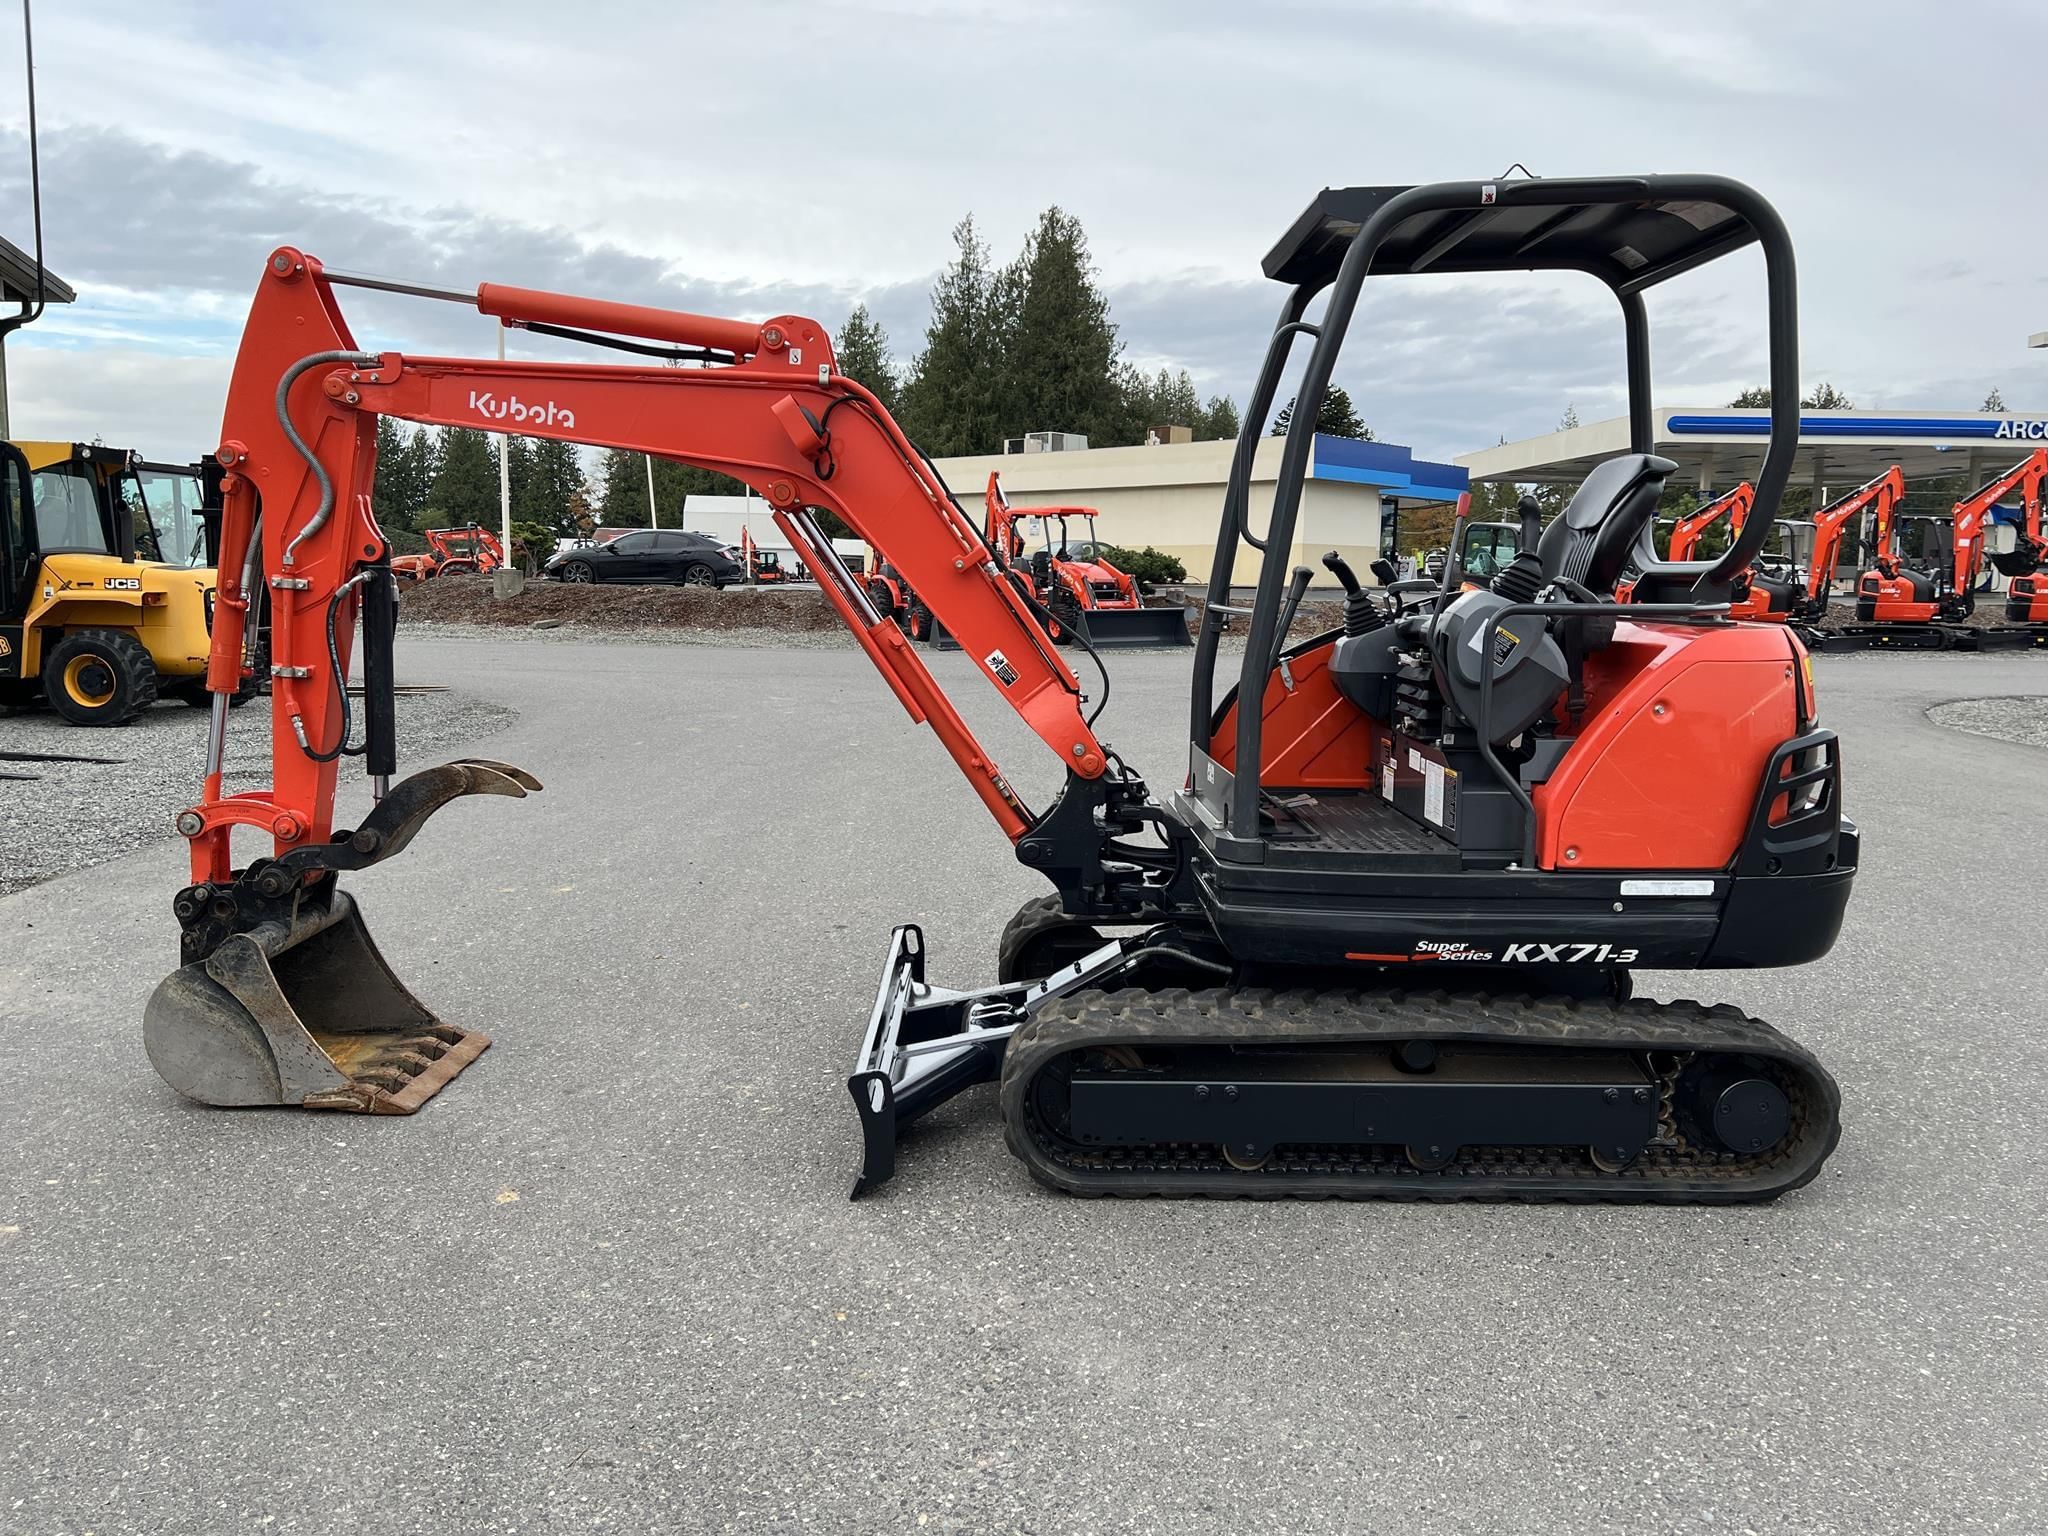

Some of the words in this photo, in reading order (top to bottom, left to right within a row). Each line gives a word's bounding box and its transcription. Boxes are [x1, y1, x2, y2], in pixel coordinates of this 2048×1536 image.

[469, 391, 575, 429] Kubota
[1995, 420, 2048, 439] ARC
[105, 579, 140, 589] JCB
[1415, 940, 1469, 954] Super
[1438, 950, 1493, 960] Series
[1500, 944, 1639, 962] KX71-3
